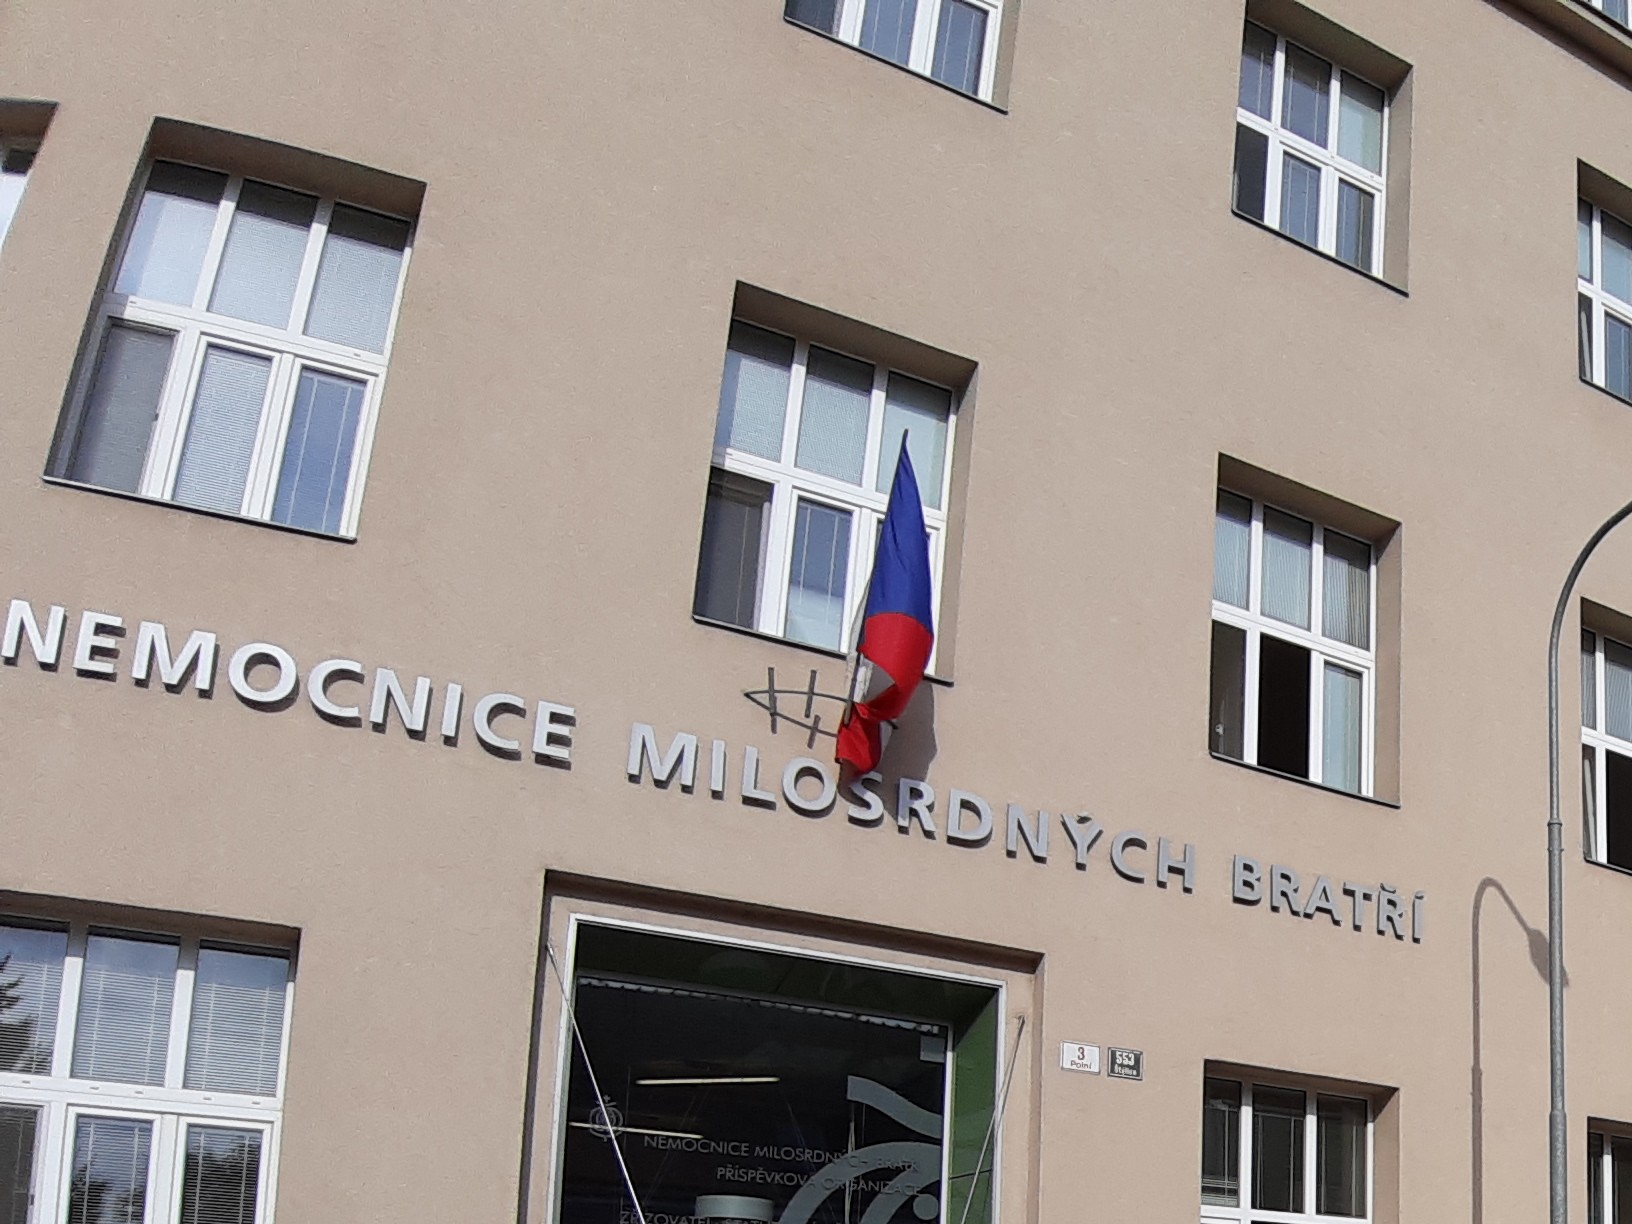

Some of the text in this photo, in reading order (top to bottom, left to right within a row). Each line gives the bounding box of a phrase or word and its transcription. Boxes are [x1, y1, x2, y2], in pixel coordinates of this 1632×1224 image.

[1, 598, 1426, 943] NEMOCNICE MILOSRDNÝCH BRATŘÍ
[1077, 1046, 1086, 1061] 3
[1116, 1051, 1135, 1066] 553
[643, 1135, 750, 1157] NEMOCNICE
